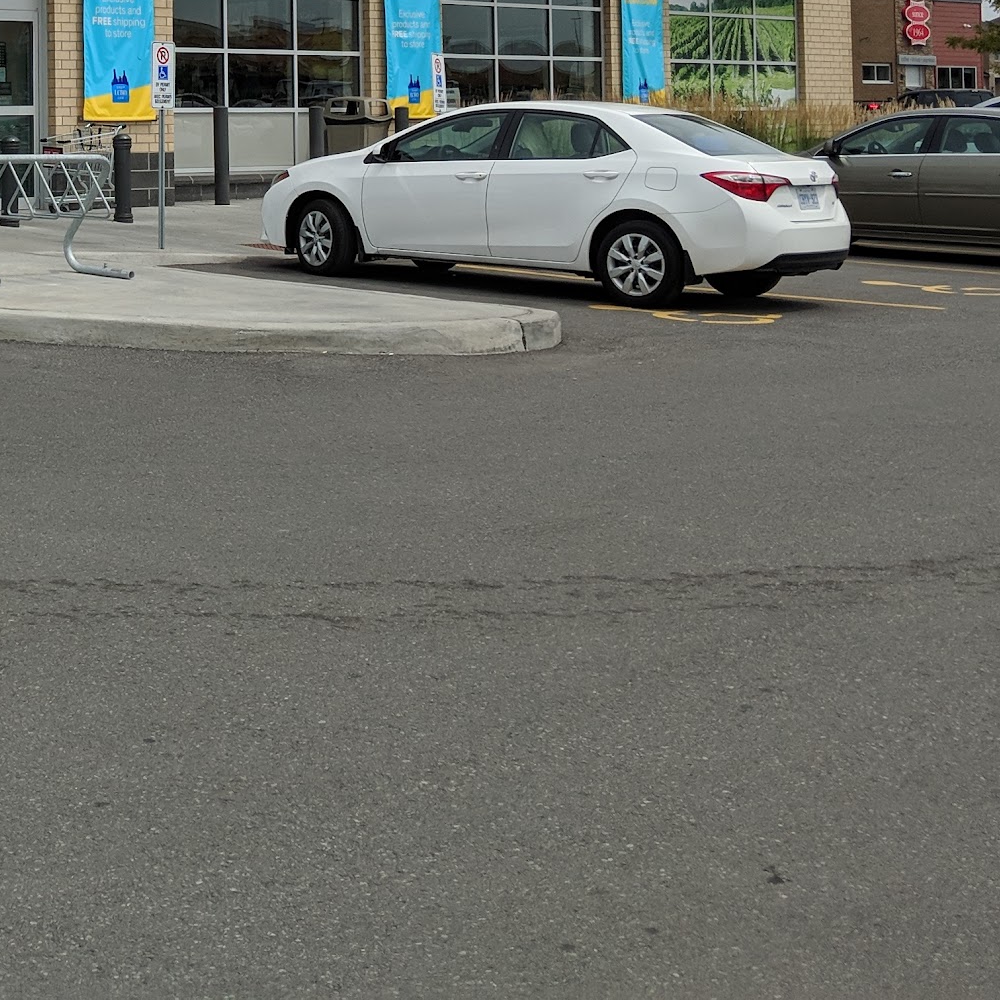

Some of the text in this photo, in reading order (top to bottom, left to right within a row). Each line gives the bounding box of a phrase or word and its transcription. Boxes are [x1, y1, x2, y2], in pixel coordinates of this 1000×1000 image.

[95, 5, 142, 15] products and
[92, 16, 146, 29] FREE shipping
[104, 29, 132, 38] to store
